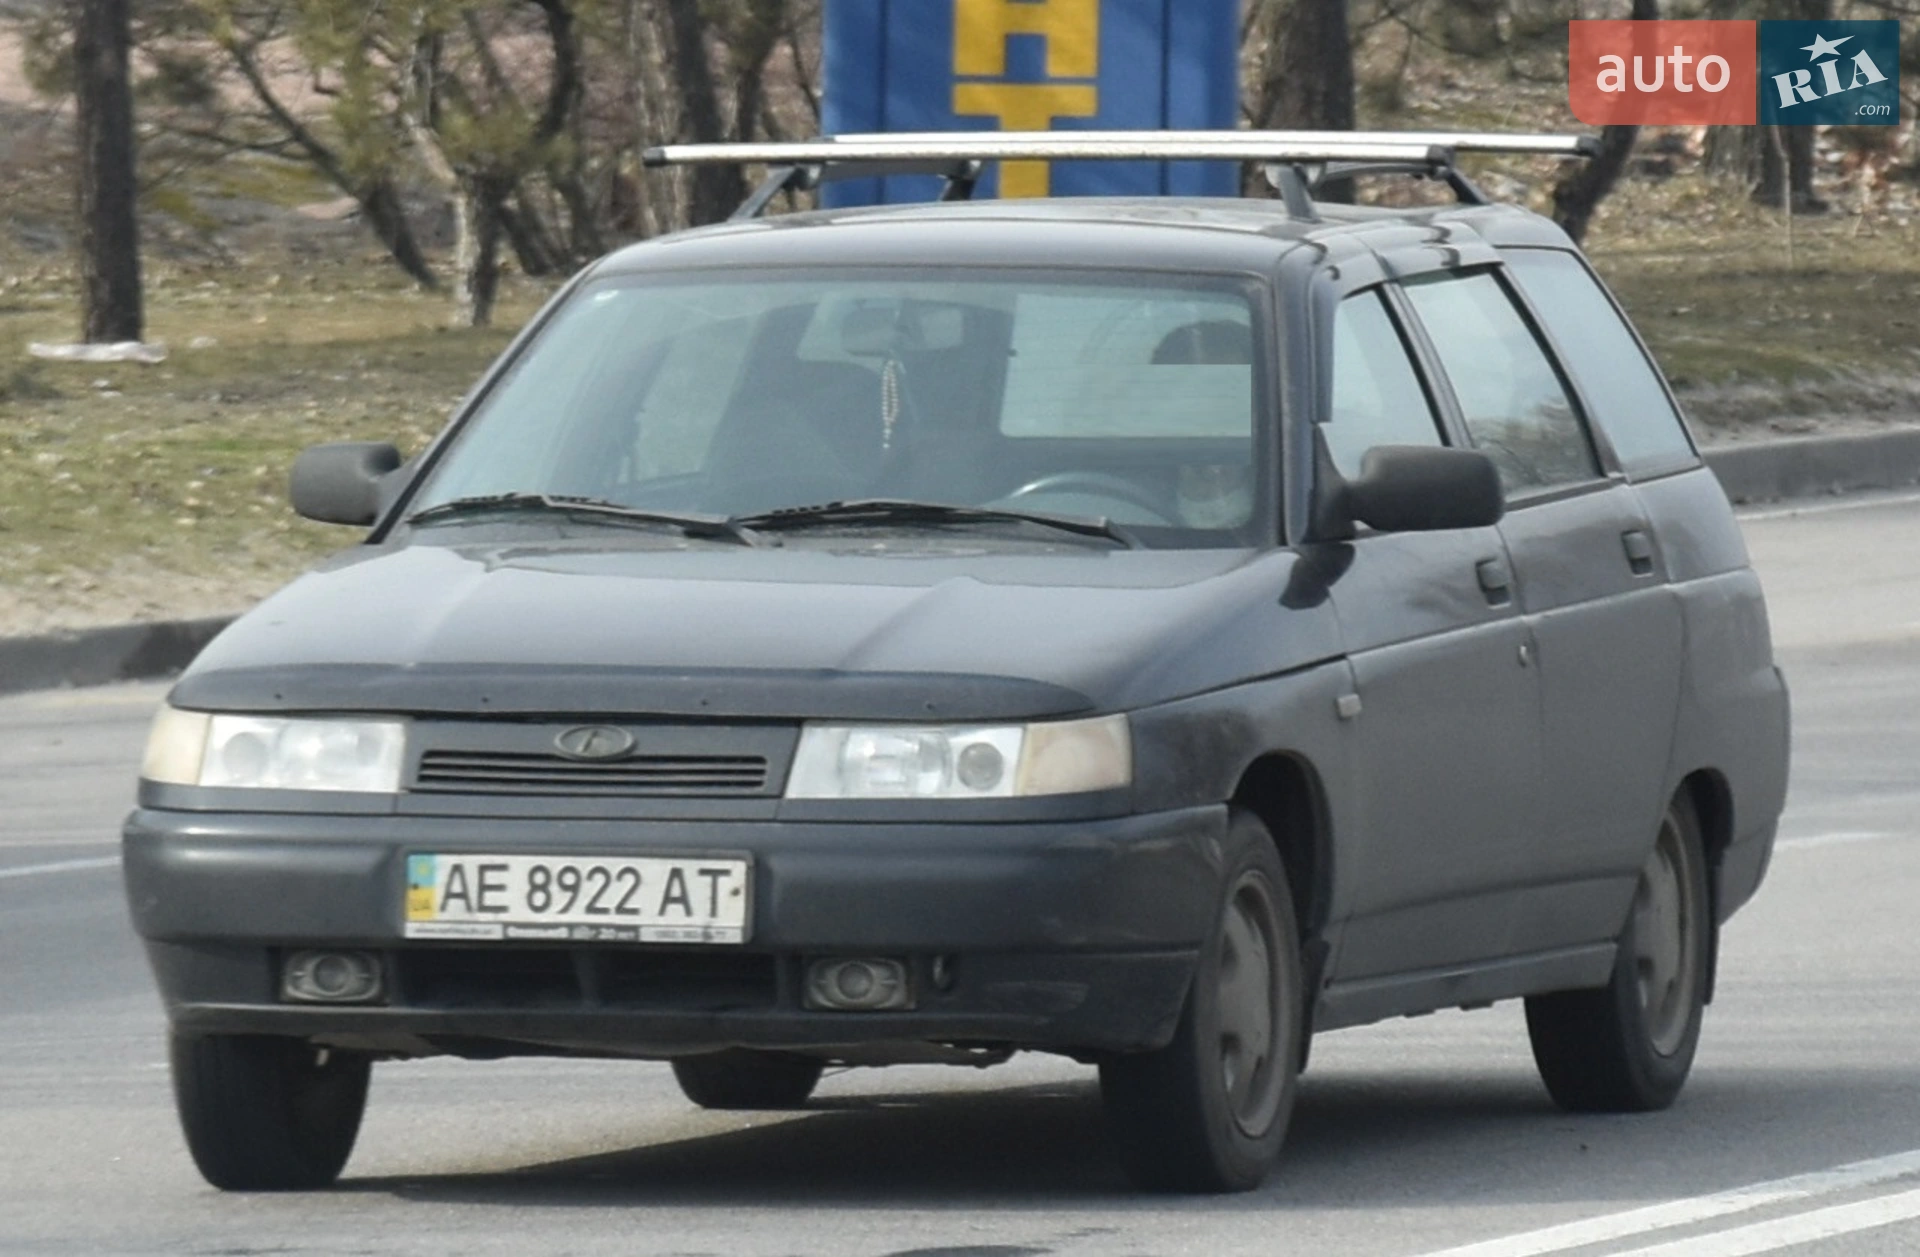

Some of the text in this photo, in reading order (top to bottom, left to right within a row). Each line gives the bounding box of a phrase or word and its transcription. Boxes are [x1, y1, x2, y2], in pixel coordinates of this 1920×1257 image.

[439, 863, 732, 918] AE 8922 AT
